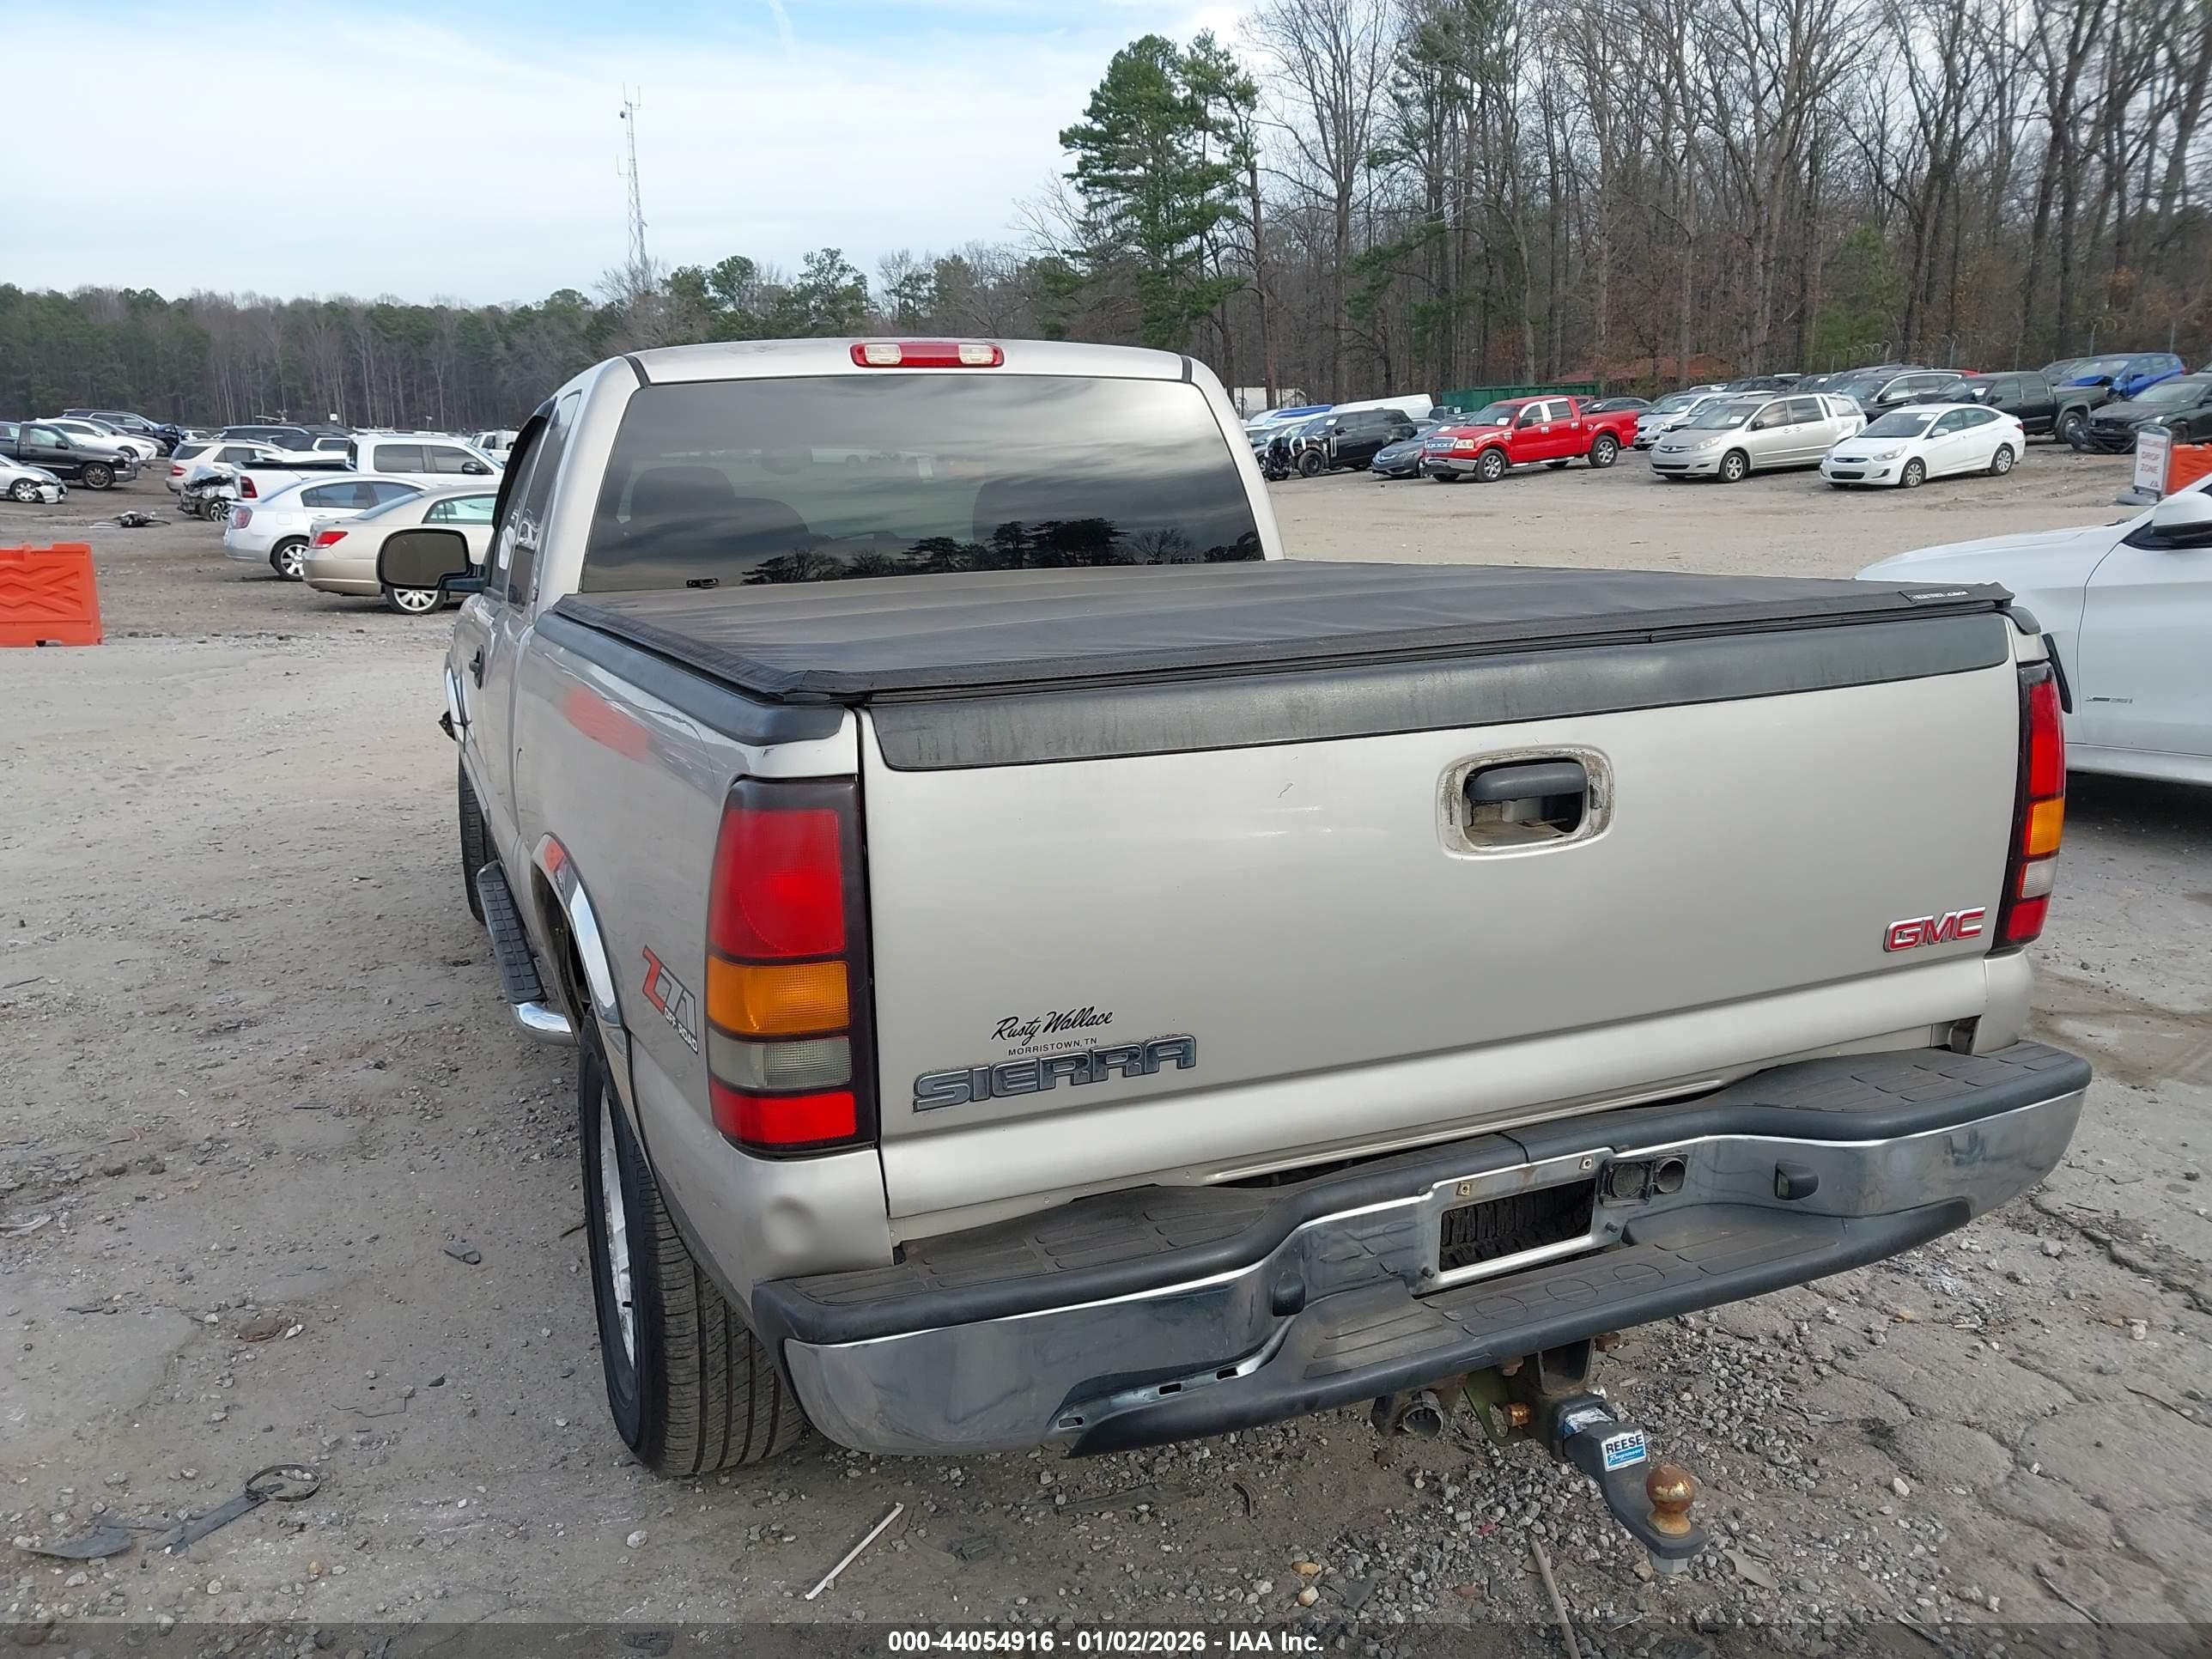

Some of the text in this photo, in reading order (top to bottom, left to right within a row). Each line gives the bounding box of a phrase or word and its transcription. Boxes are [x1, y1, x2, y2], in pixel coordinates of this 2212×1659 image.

[1883, 907, 1985, 952] GMC
[642, 945, 697, 1038] Z71
[991, 1006, 1113, 1046] Rusty Wallace
[1008, 1040, 1082, 1056] MORRISTOWN,
[913, 1035, 1197, 1113] SIERRA
[1606, 1434, 1644, 1454] REESE
